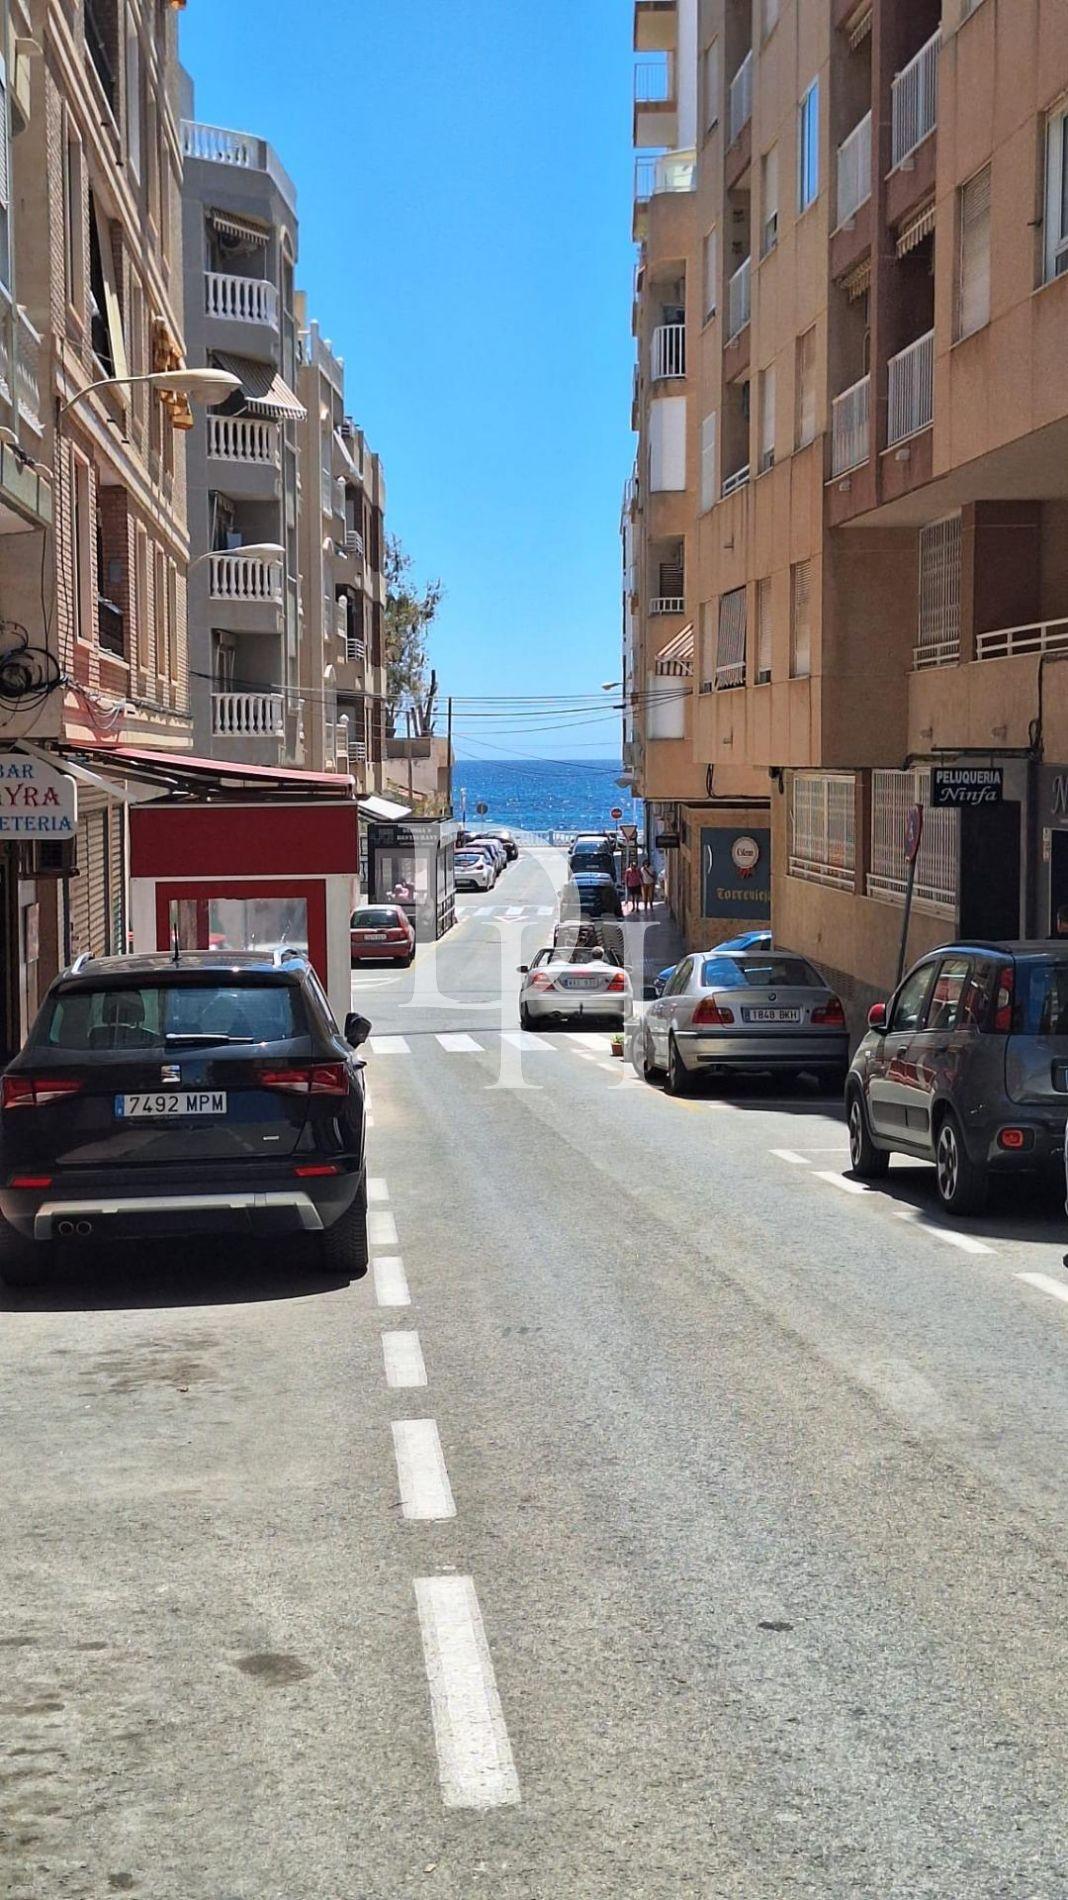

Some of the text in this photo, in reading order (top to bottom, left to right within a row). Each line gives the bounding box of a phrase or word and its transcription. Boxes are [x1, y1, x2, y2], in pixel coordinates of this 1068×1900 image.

[936, 770, 1001, 784] PELUQUERIA
[0, 783, 60, 807] YRA
[940, 786, 998, 806] Ninfa
[129, 1094, 223, 1113] 7492 MPM
